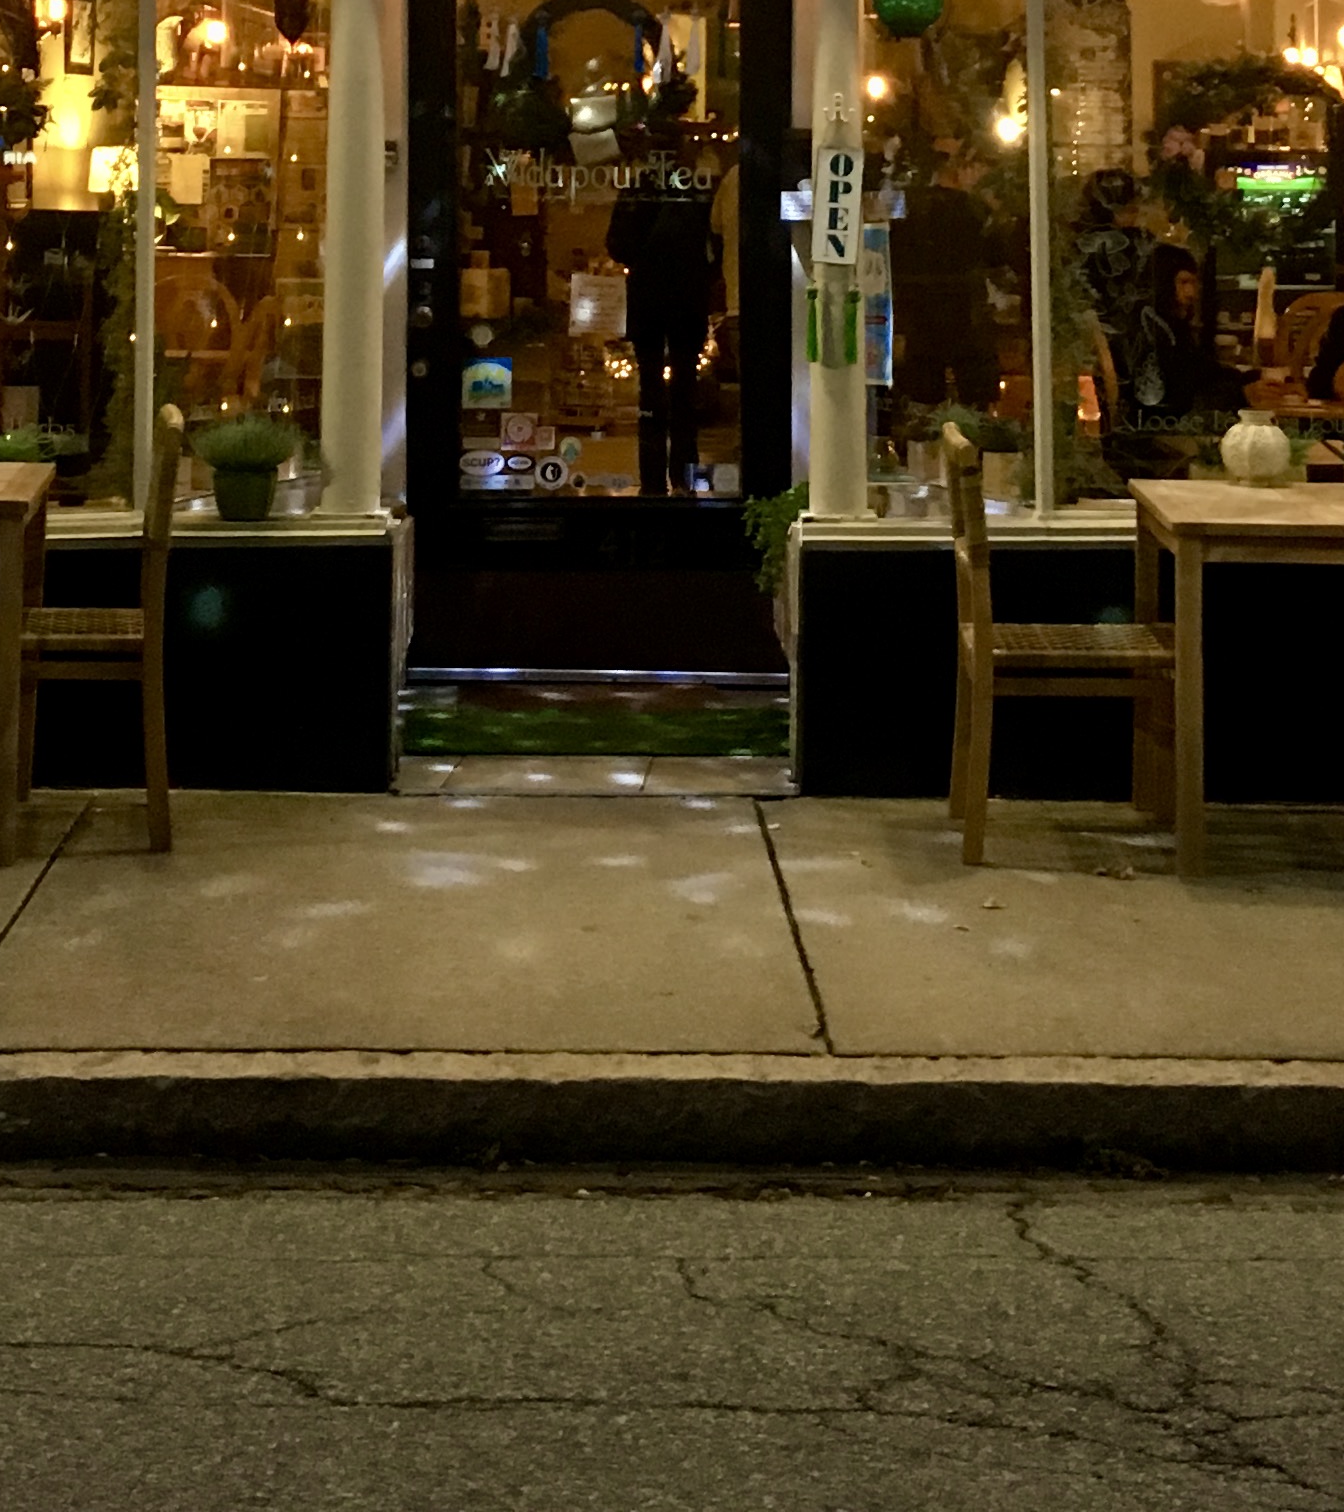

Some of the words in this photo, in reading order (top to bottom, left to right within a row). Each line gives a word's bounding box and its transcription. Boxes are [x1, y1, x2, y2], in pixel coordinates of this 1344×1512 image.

[569, 162, 649, 209] pour
[647, 149, 713, 191] Tea
[823, 153, 855, 258] OPEN
